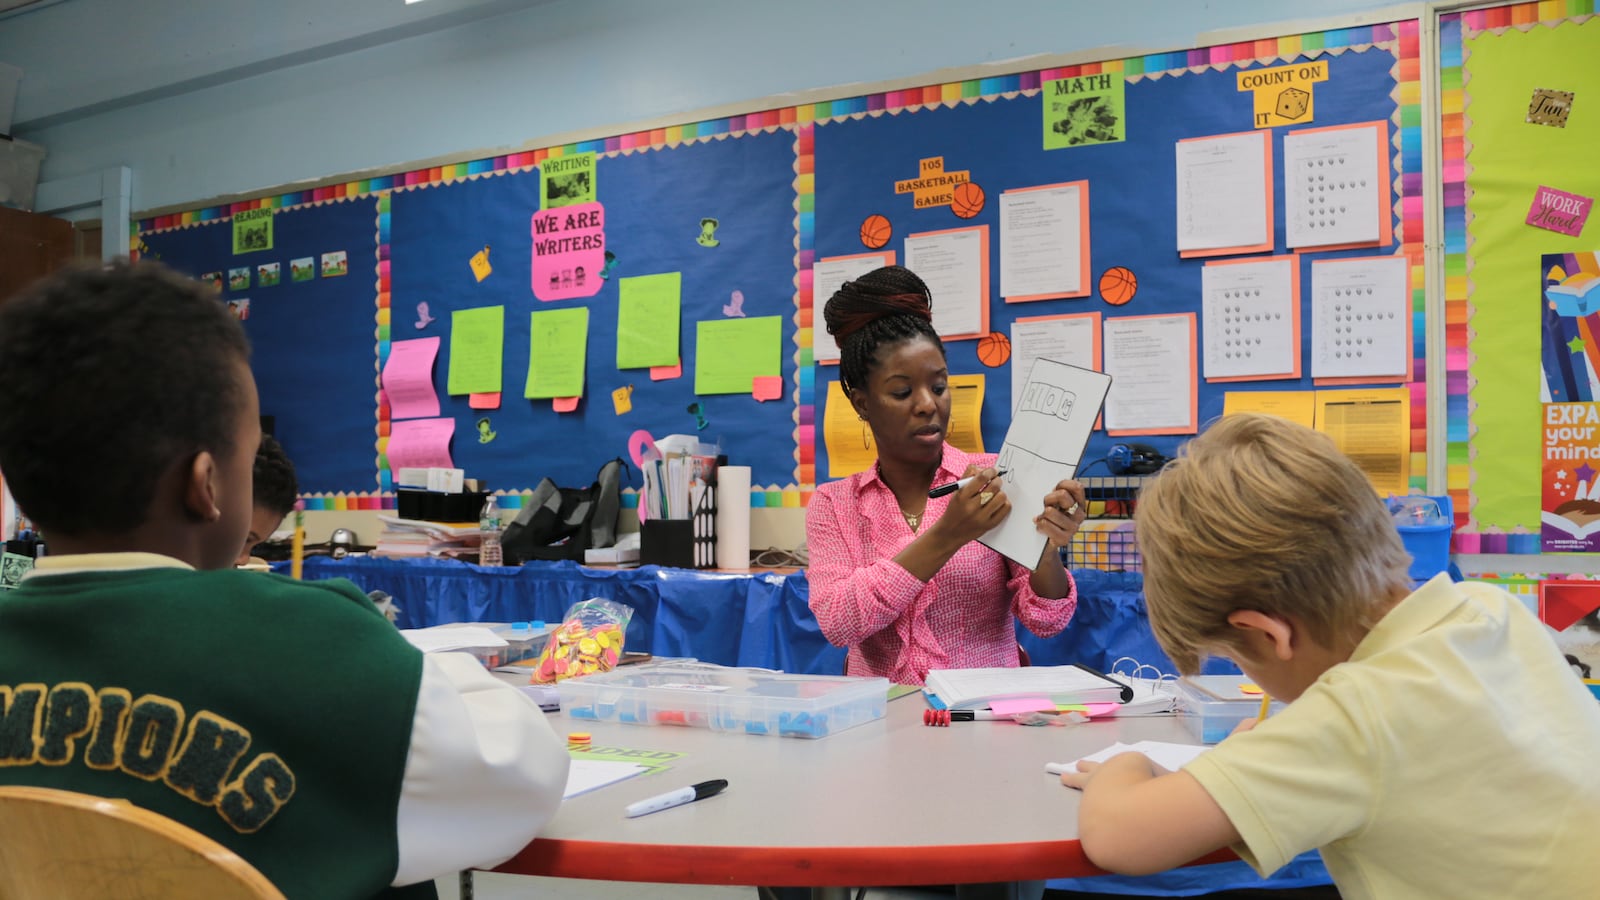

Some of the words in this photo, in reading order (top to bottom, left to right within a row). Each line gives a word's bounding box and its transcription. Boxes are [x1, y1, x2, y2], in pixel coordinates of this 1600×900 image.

[1055, 74, 1111, 96] MATH
[1242, 69, 1295, 89] COUNT
[1299, 65, 1321, 80] ON
[1256, 112, 1271, 126] IT
[543, 156, 591, 174] WRITING
[922, 160, 941, 171] 105
[898, 174, 968, 192] BASKETBALL
[915, 193, 953, 207] GAMES
[1541, 191, 1585, 216] WORK
[235, 207, 271, 223] READING
[535, 214, 559, 235] WE
[564, 210, 601, 231] ARE
[1532, 204, 1582, 230] Hard
[535, 234, 603, 256] WRITERS
[1546, 404, 1600, 425] EXPA
[1545, 427, 1596, 446] your
[1546, 442, 1600, 461] mind
